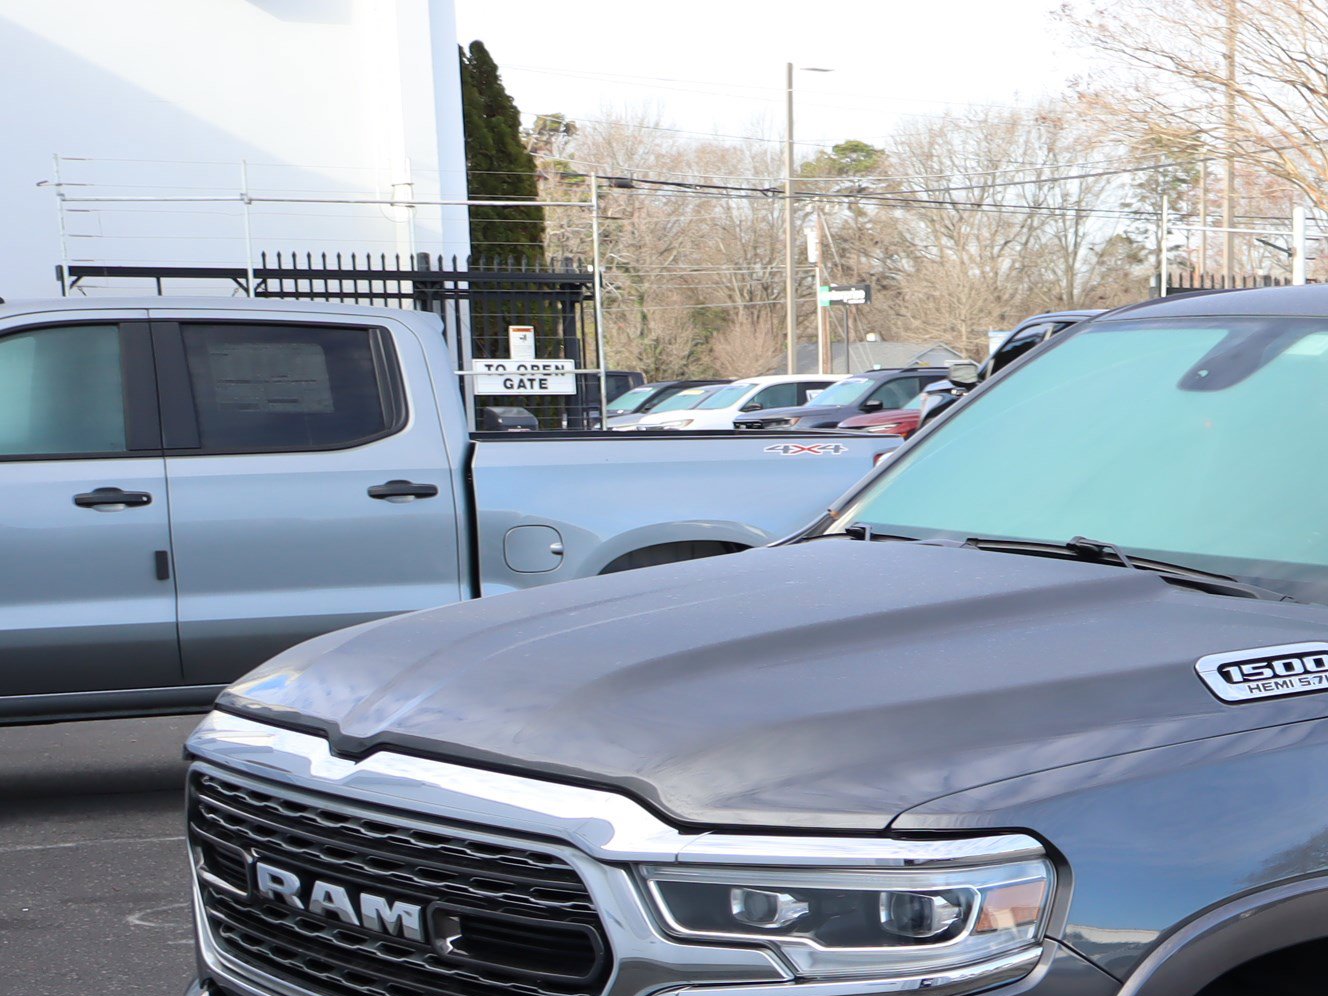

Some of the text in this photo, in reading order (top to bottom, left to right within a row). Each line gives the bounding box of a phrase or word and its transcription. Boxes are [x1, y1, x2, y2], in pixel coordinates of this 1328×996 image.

[484, 364, 565, 376] TO OPEN
[503, 378, 549, 390] GATE
[1248, 678, 1295, 694] HEMI
[256, 861, 426, 943] RAM
